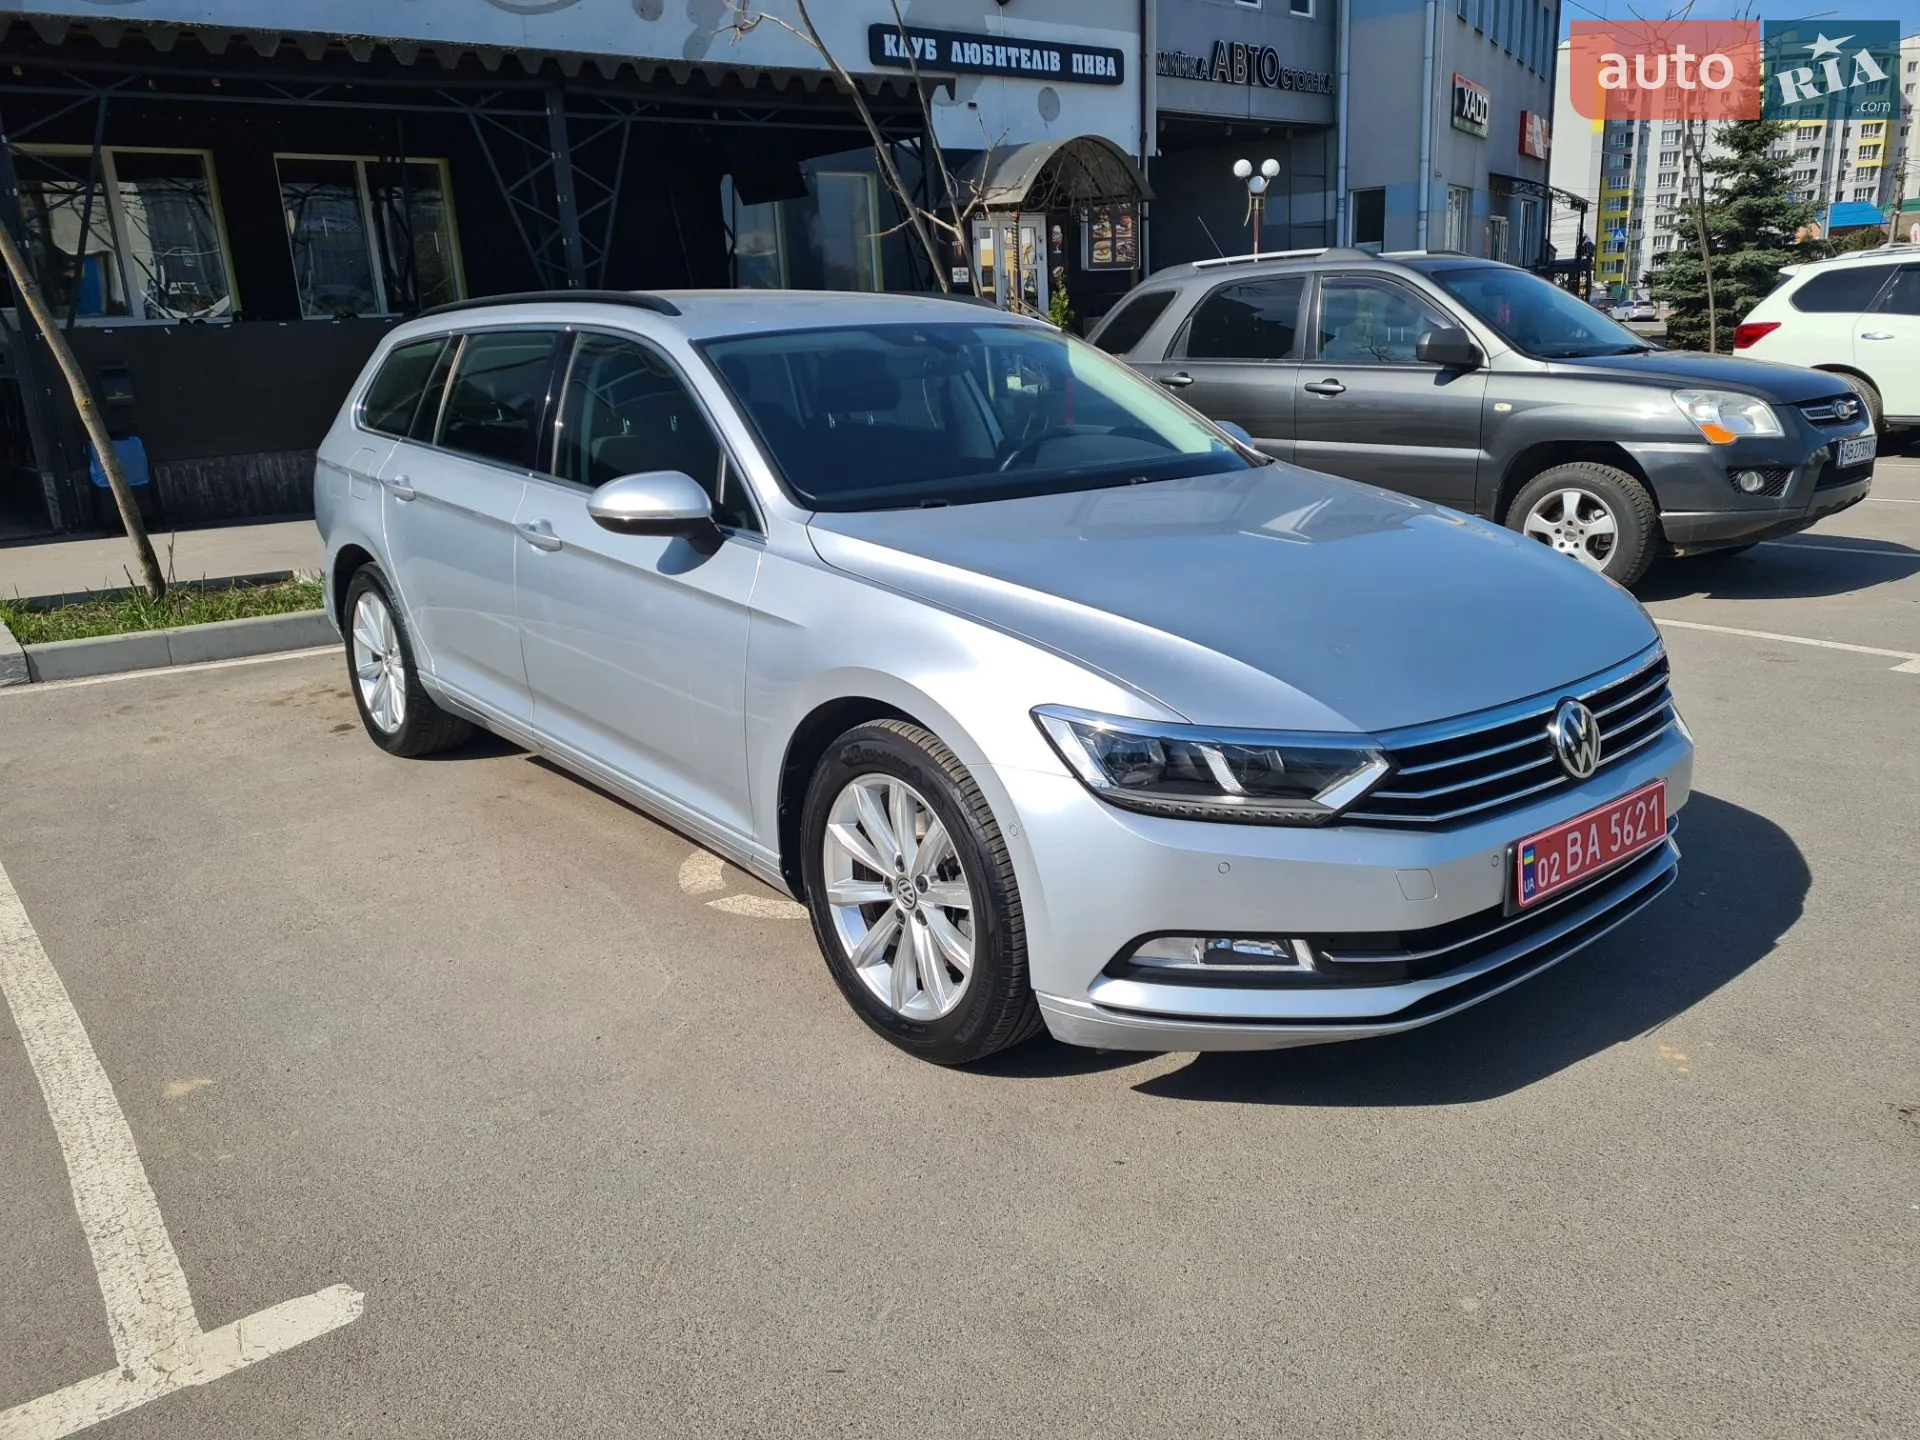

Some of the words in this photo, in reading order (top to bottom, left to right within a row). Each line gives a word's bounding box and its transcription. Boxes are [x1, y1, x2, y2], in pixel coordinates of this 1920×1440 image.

[883, 34, 937, 61] КЛУБ
[951, 41, 1061, 72] ЛЮБИТЕЛІВ
[1072, 53, 1117, 77] ПИВА
[1212, 39, 1281, 87] АВТО
[1537, 852, 1561, 888] 02
[1566, 823, 1601, 875] BA
[1609, 794, 1660, 852] 5621
[1523, 876, 1535, 894] UA
